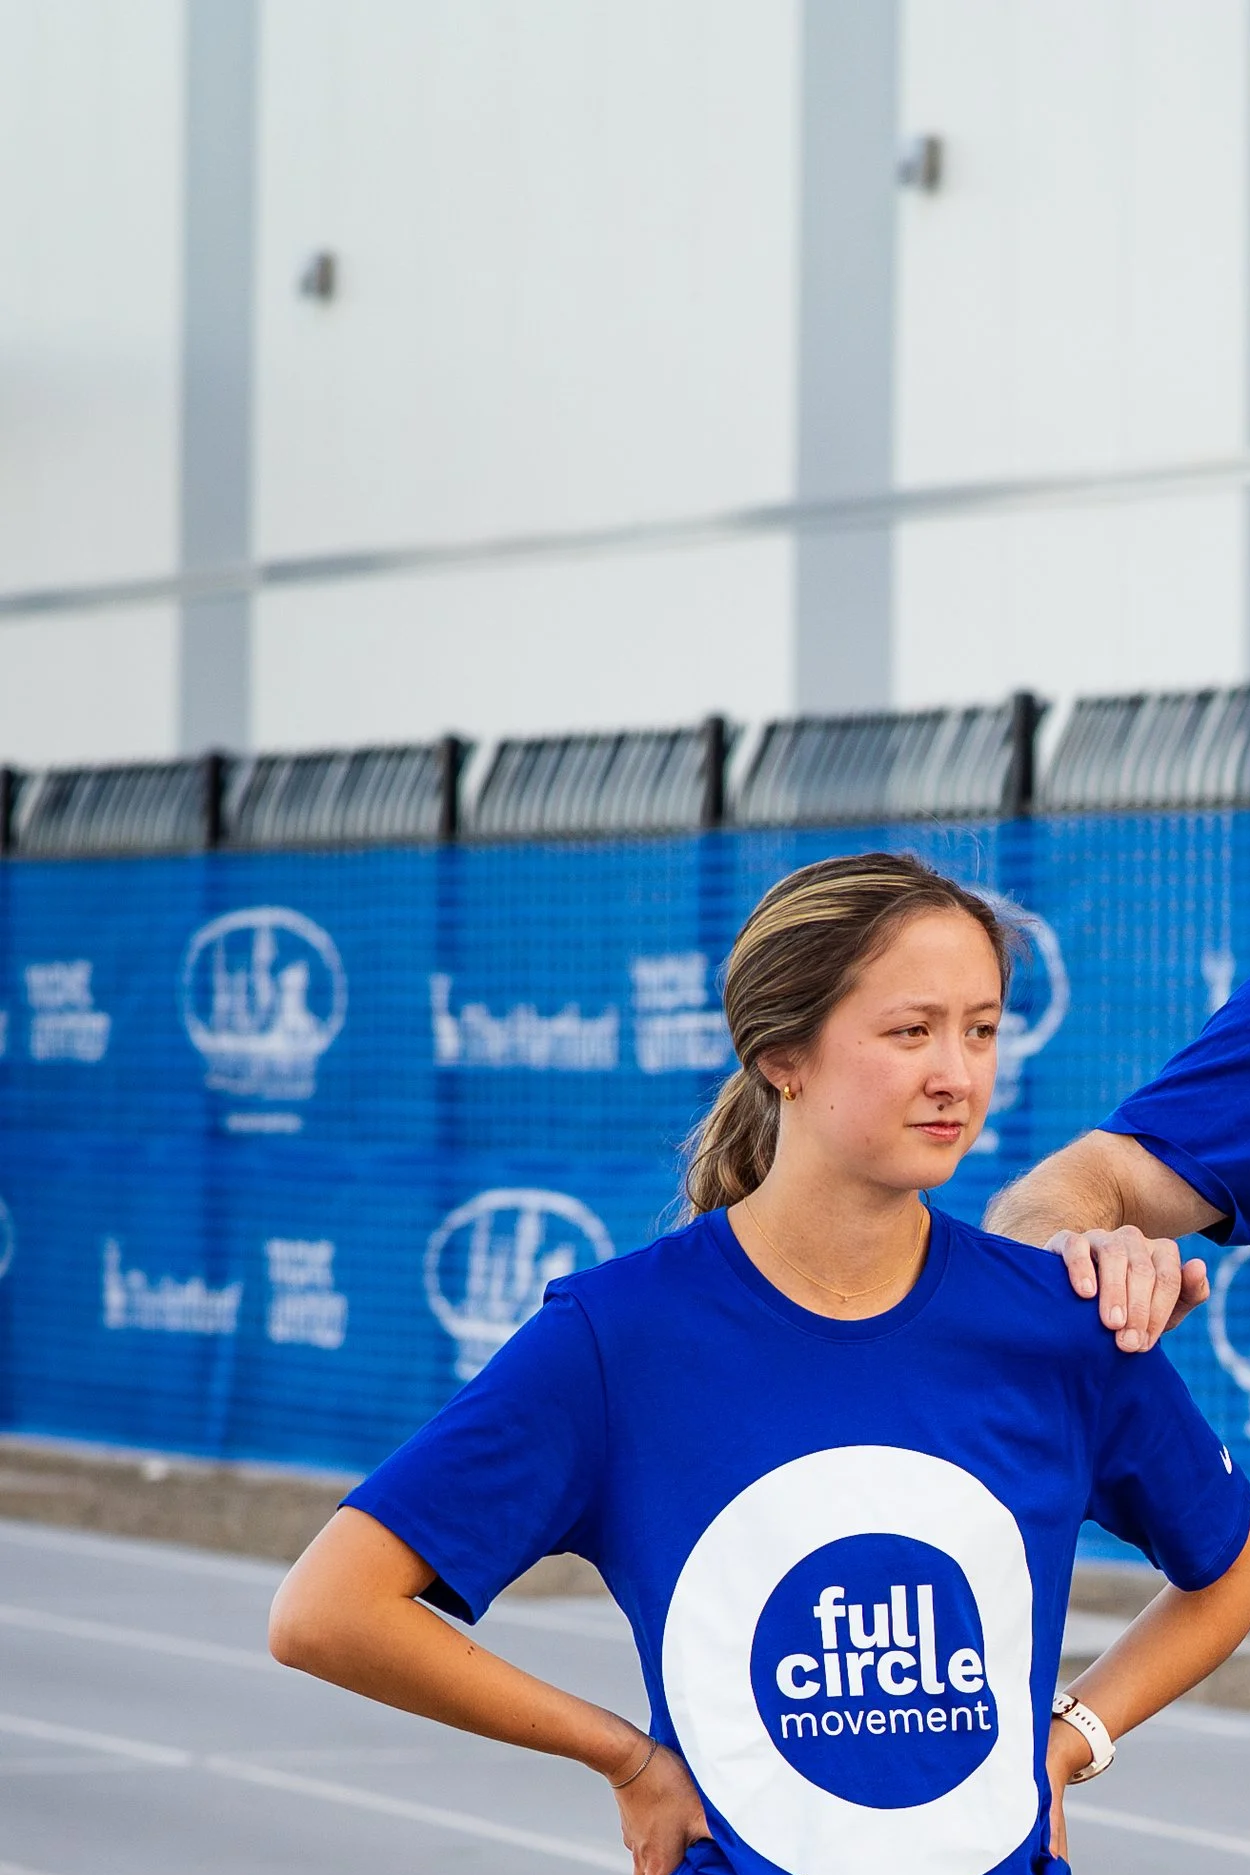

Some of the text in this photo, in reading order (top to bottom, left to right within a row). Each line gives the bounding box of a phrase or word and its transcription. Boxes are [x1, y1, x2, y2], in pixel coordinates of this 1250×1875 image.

[813, 1584, 934, 1650] full
[776, 1647, 984, 1699] circle
[781, 1700, 991, 1738] movement
